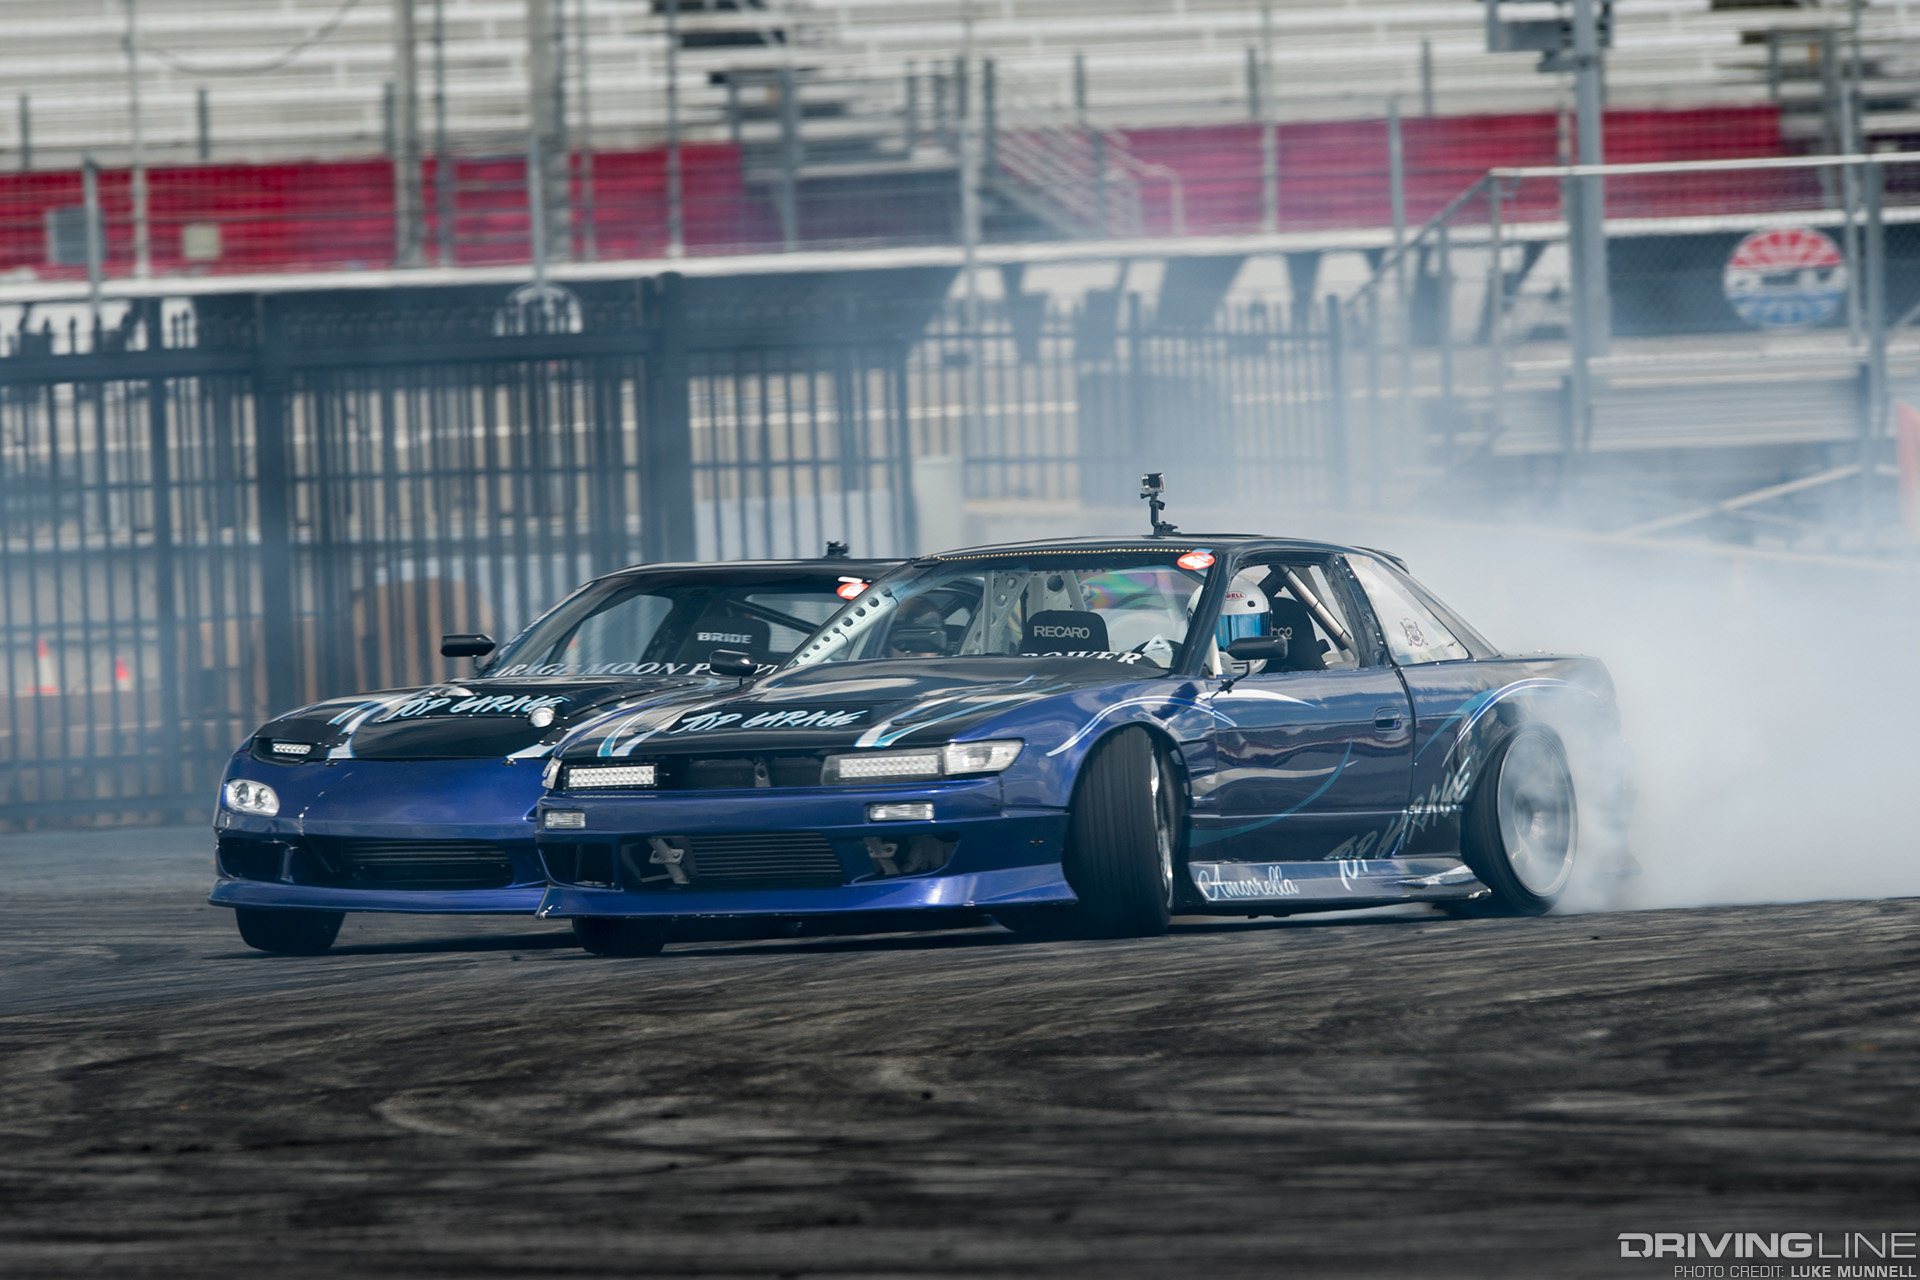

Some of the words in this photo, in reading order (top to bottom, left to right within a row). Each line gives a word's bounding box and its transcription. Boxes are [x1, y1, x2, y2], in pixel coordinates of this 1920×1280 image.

[697, 632, 751, 644] BRIDE
[1033, 625, 1090, 639] RECARO
[1021, 651, 1142, 665] WER
[579, 662, 687, 675] MOON
[669, 711, 743, 735] TOP
[741, 710, 868, 728] GARAGE
